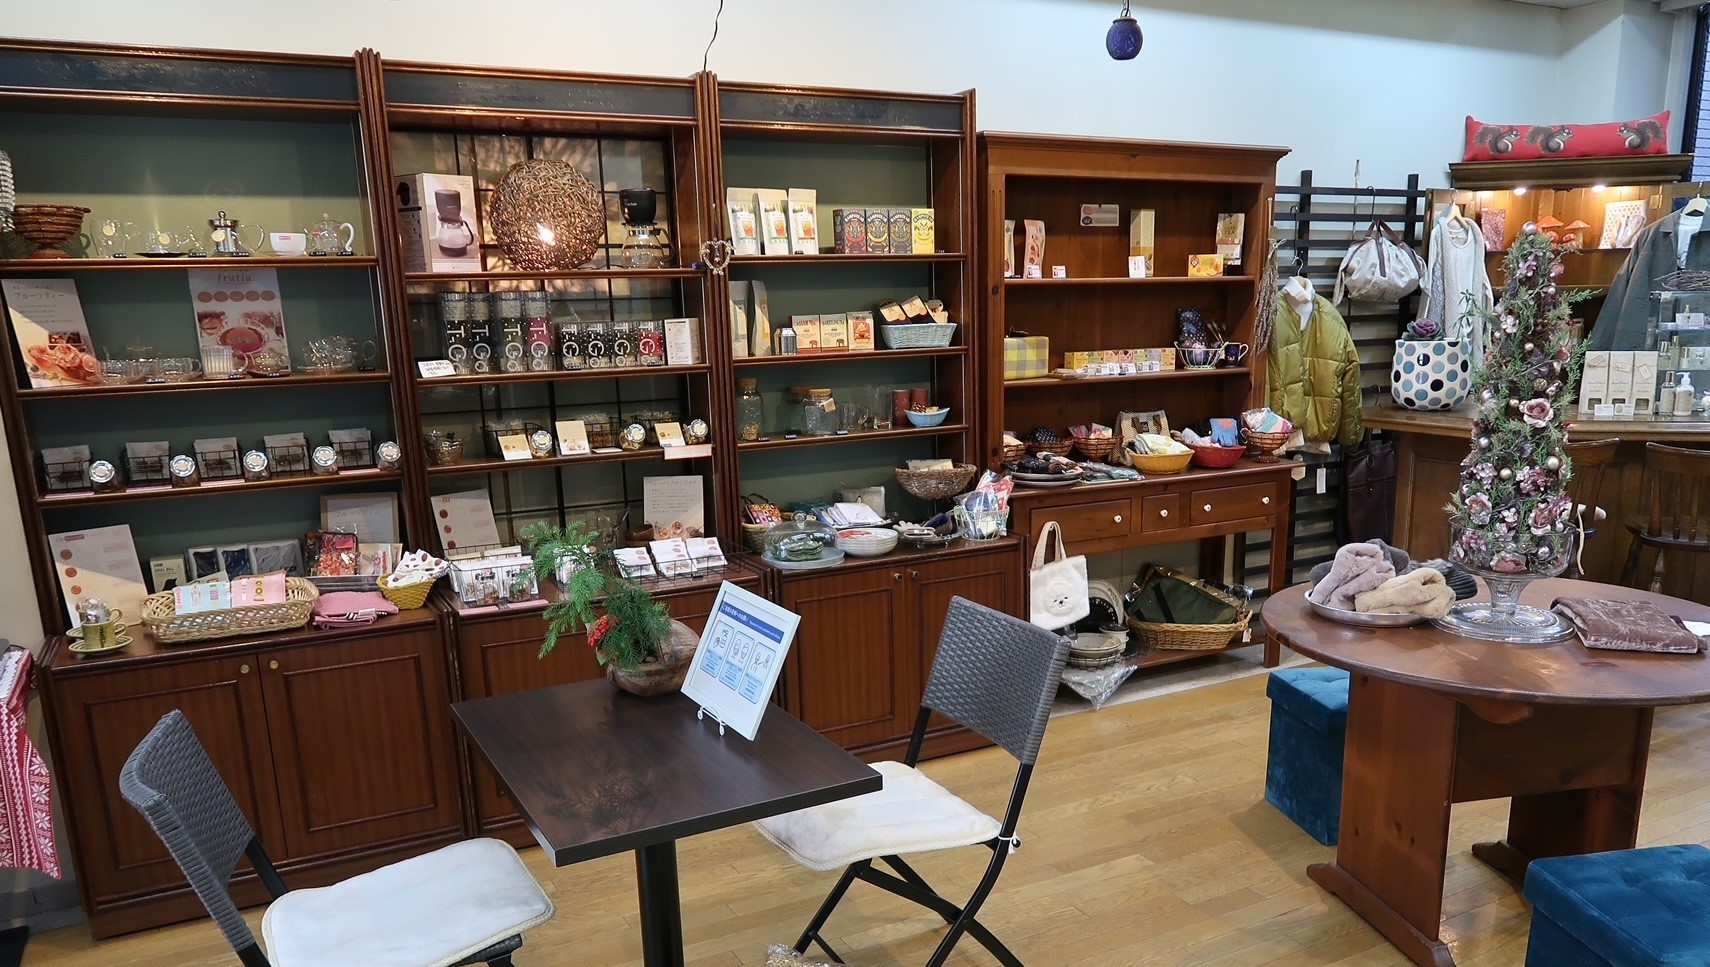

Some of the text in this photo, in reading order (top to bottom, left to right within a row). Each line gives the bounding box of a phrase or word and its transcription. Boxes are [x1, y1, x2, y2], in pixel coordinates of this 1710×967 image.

[217, 273, 252, 284] frutia
[504, 323, 523, 371] T-Go
[530, 322, 549, 370] T-Go
